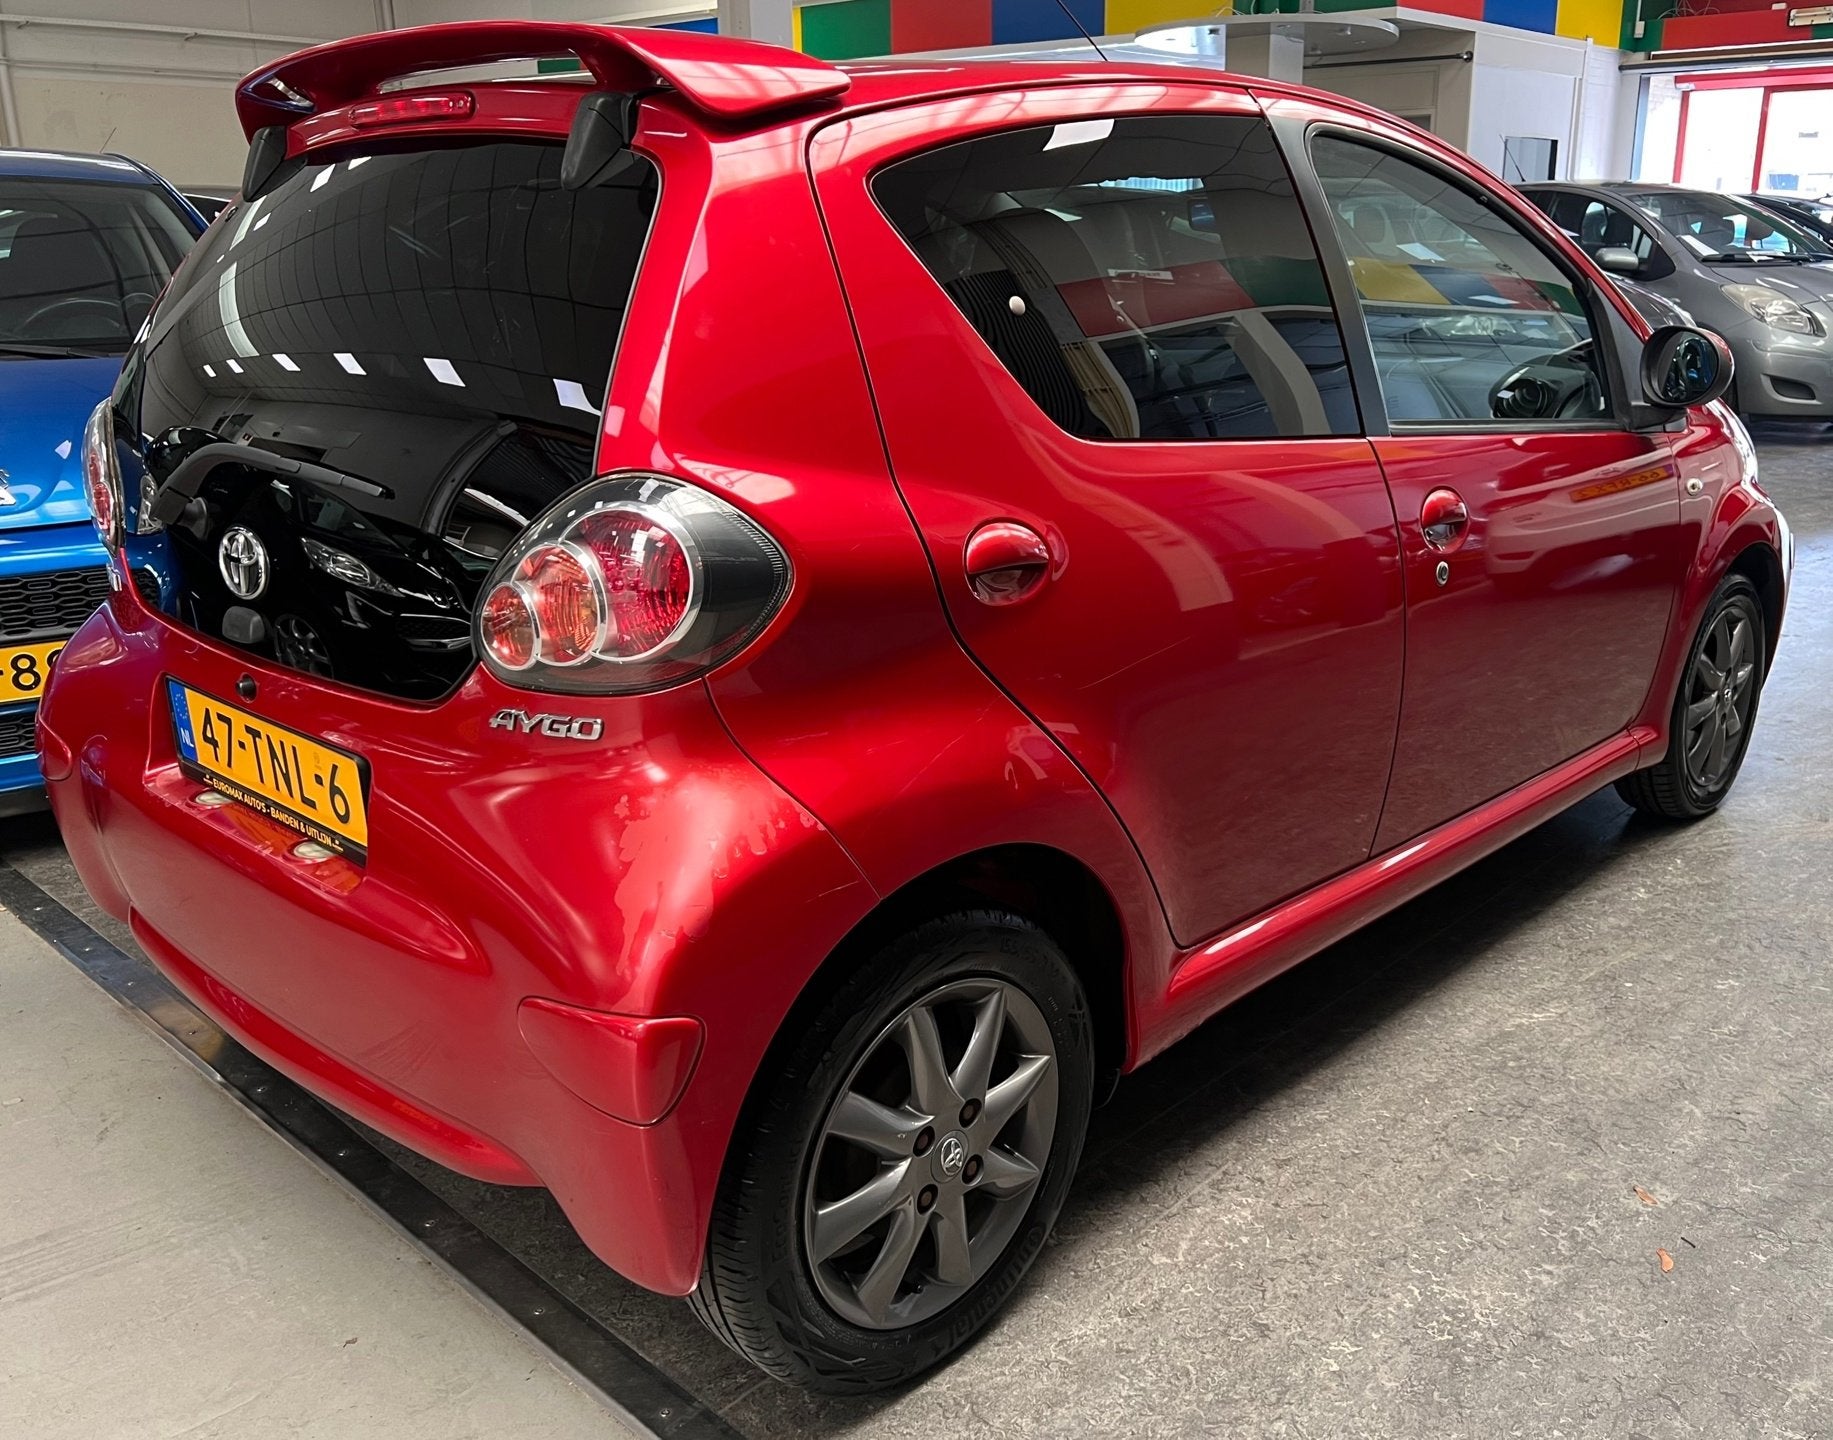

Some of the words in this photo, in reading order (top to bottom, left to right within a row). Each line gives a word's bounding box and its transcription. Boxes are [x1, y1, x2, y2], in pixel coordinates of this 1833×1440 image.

[180, 727, 195, 748] NL
[489, 708, 603, 741] AYGO
[202, 707, 350, 824] 47-TNL-6
[212, 778, 243, 801] EUROMAX
[244, 794, 267, 813] AUTO'S
[270, 807, 300, 830] BANDEN
